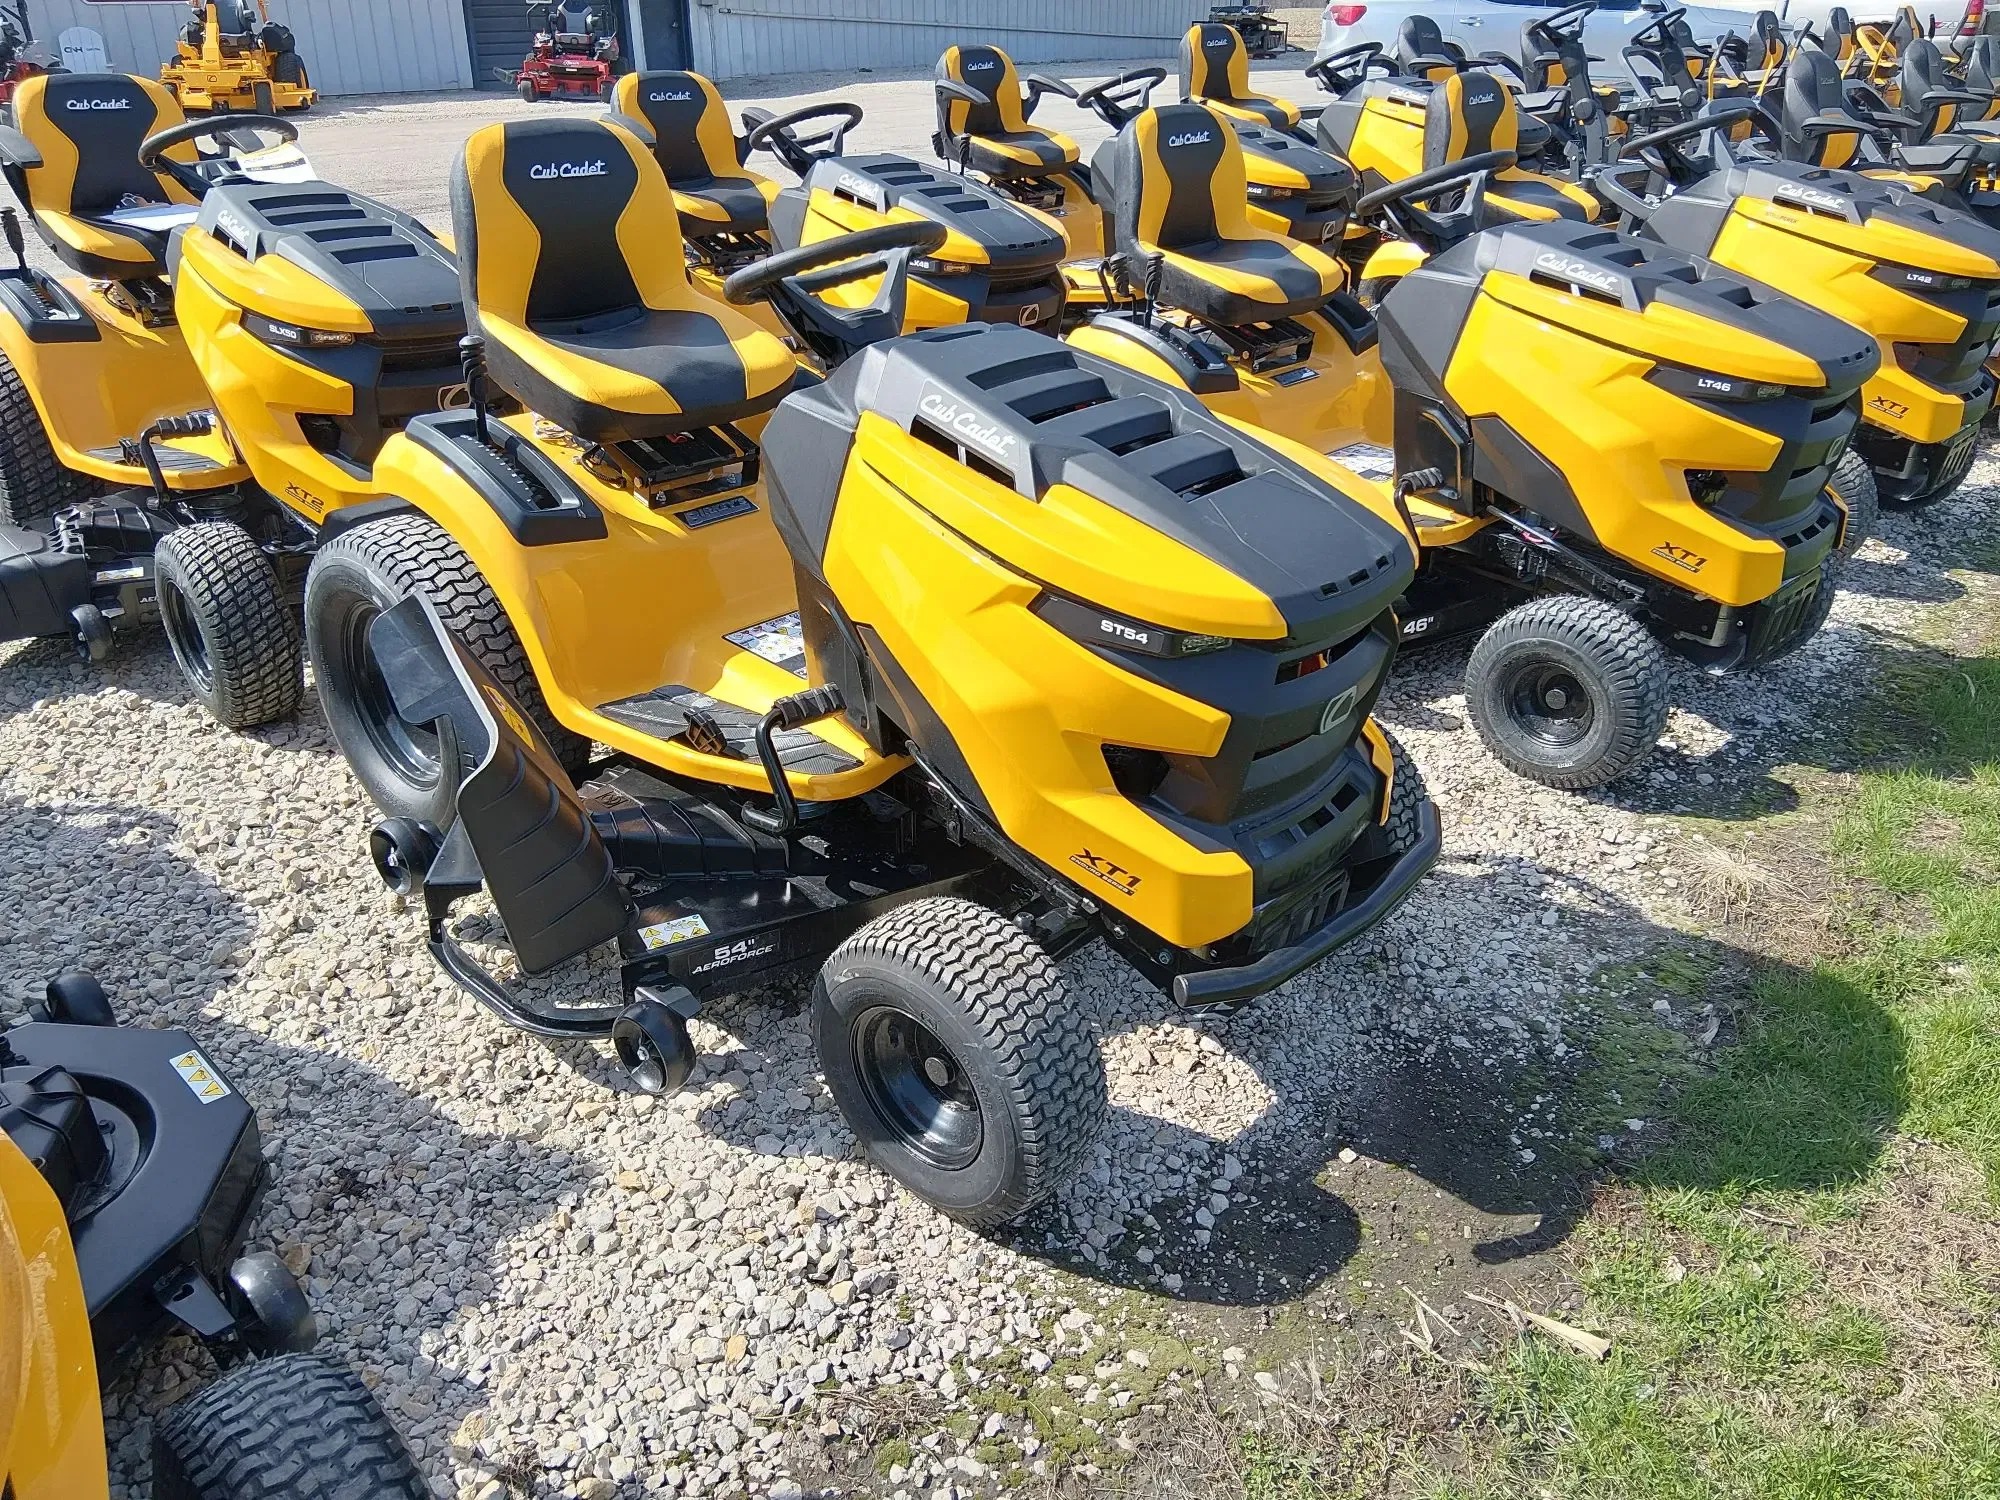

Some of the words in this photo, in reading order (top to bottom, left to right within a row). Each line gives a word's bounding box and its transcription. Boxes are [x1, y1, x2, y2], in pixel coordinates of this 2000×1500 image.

[67, 99, 90, 110] Cub
[91, 98, 131, 109] Cadet
[650, 92, 665, 101] Cub
[665, 91, 692, 101] Cadet
[1169, 134, 1183, 147] Cub
[1184, 131, 1211, 145] Cadet
[530, 162, 559, 179] Cub
[559, 159, 607, 178] Cadet
[1777, 183, 1804, 197] Cub
[1801, 190, 1845, 209] Cadet
[1537, 253, 1568, 272] Cub
[1564, 263, 1618, 290] Cadet
[1906, 273, 1933, 284] LT42
[268, 324, 297, 340] SLX50
[1698, 378, 1732, 392] LT46
[1871, 395, 1910, 414] XT1
[919, 394, 958, 423] Cub
[952, 412, 1017, 458] Cadet
[286, 480, 325, 509] XT2
[1655, 541, 1708, 567] XT1
[1100, 619, 1149, 645] ST54
[1403, 616, 1434, 634] 46"
[1073, 847, 1142, 888] XT1
[692, 944, 774, 975] AEROFORCE
[714, 938, 756, 961] 54"
